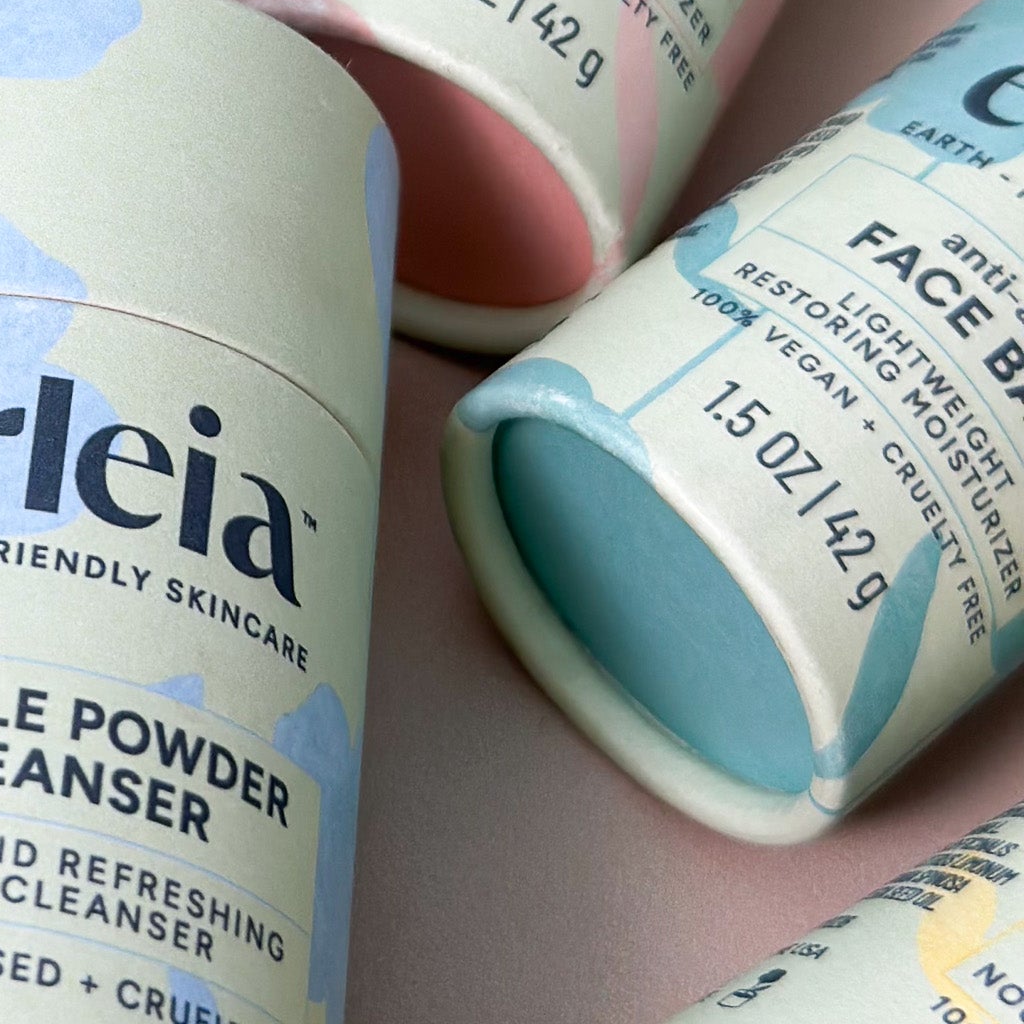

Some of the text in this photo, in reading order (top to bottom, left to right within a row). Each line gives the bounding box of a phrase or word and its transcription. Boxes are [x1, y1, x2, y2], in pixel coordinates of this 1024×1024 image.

[532, 0, 582, 60] 42
[575, 48, 604, 89] g
[660, 31, 696, 93] FREE
[900, 120, 995, 170] EARTH
[846, 219, 994, 340] FACE
[703, 379, 772, 438] 1.5
[733, 261, 1023, 601] RESTORING MOISTURIZER
[837, 291, 1016, 492] LIGHTWEIGHT
[690, 286, 760, 328] 100%
[762, 324, 859, 410] VEGAN
[881, 441, 967, 570] CRUELTY
[956, 575, 988, 647] FREE
[755, 430, 824, 496] OZ
[824, 508, 877, 573] 42
[165, 577, 309, 673] SKINCARE
[846, 570, 889, 611] g
[69, 696, 291, 829] POWDER
[0, 875, 214, 964] CLEANSER
[58, 848, 286, 964] REFRESHING
[116, 979, 239, 1024] CRUE
